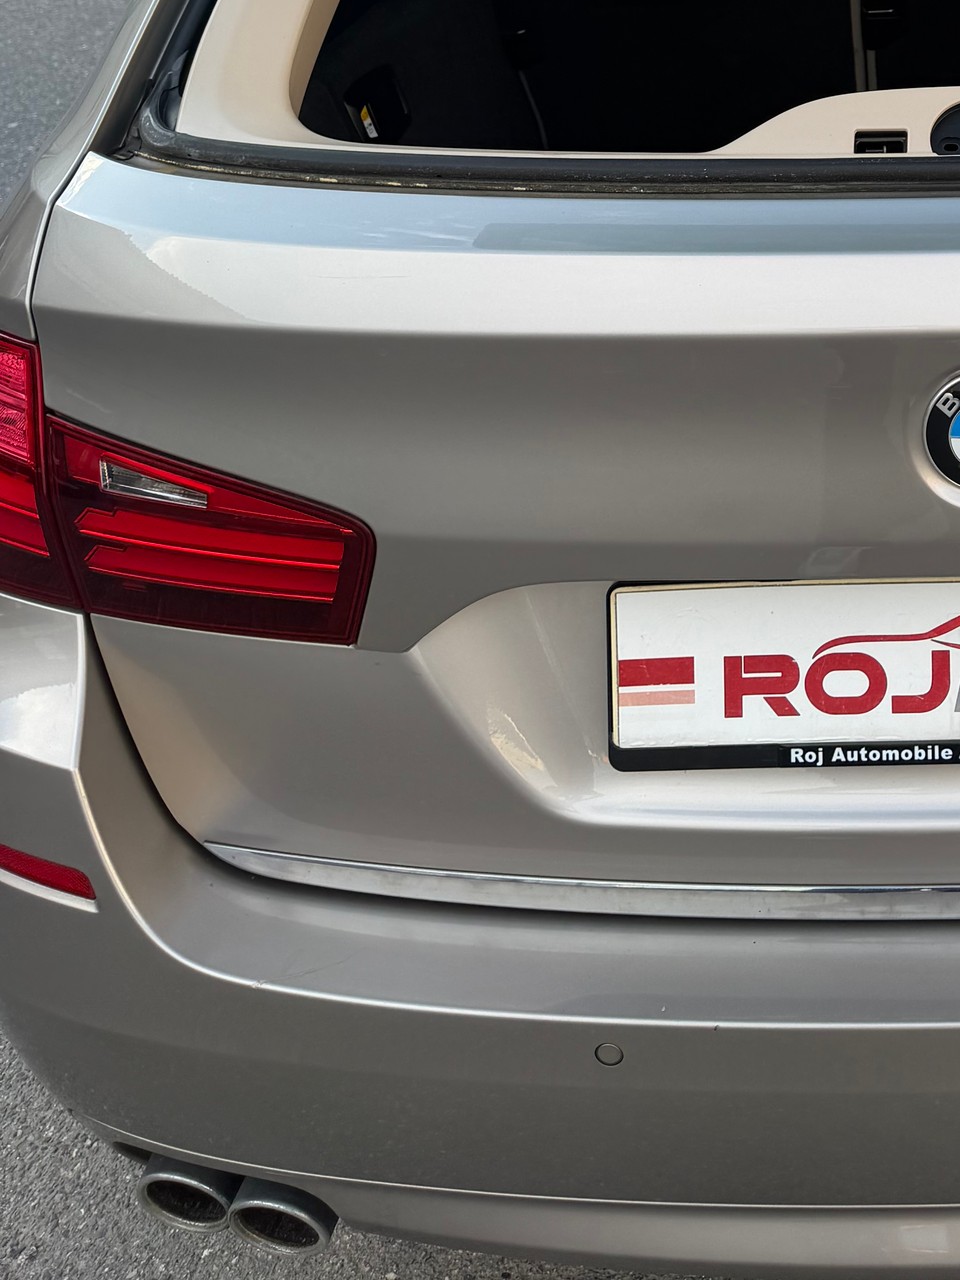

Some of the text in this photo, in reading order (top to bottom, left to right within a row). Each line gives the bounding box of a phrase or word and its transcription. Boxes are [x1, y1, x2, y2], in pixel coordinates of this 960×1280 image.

[723, 649, 951, 719] ROJ
[790, 747, 824, 766] Roj
[831, 745, 953, 763] Automobile
